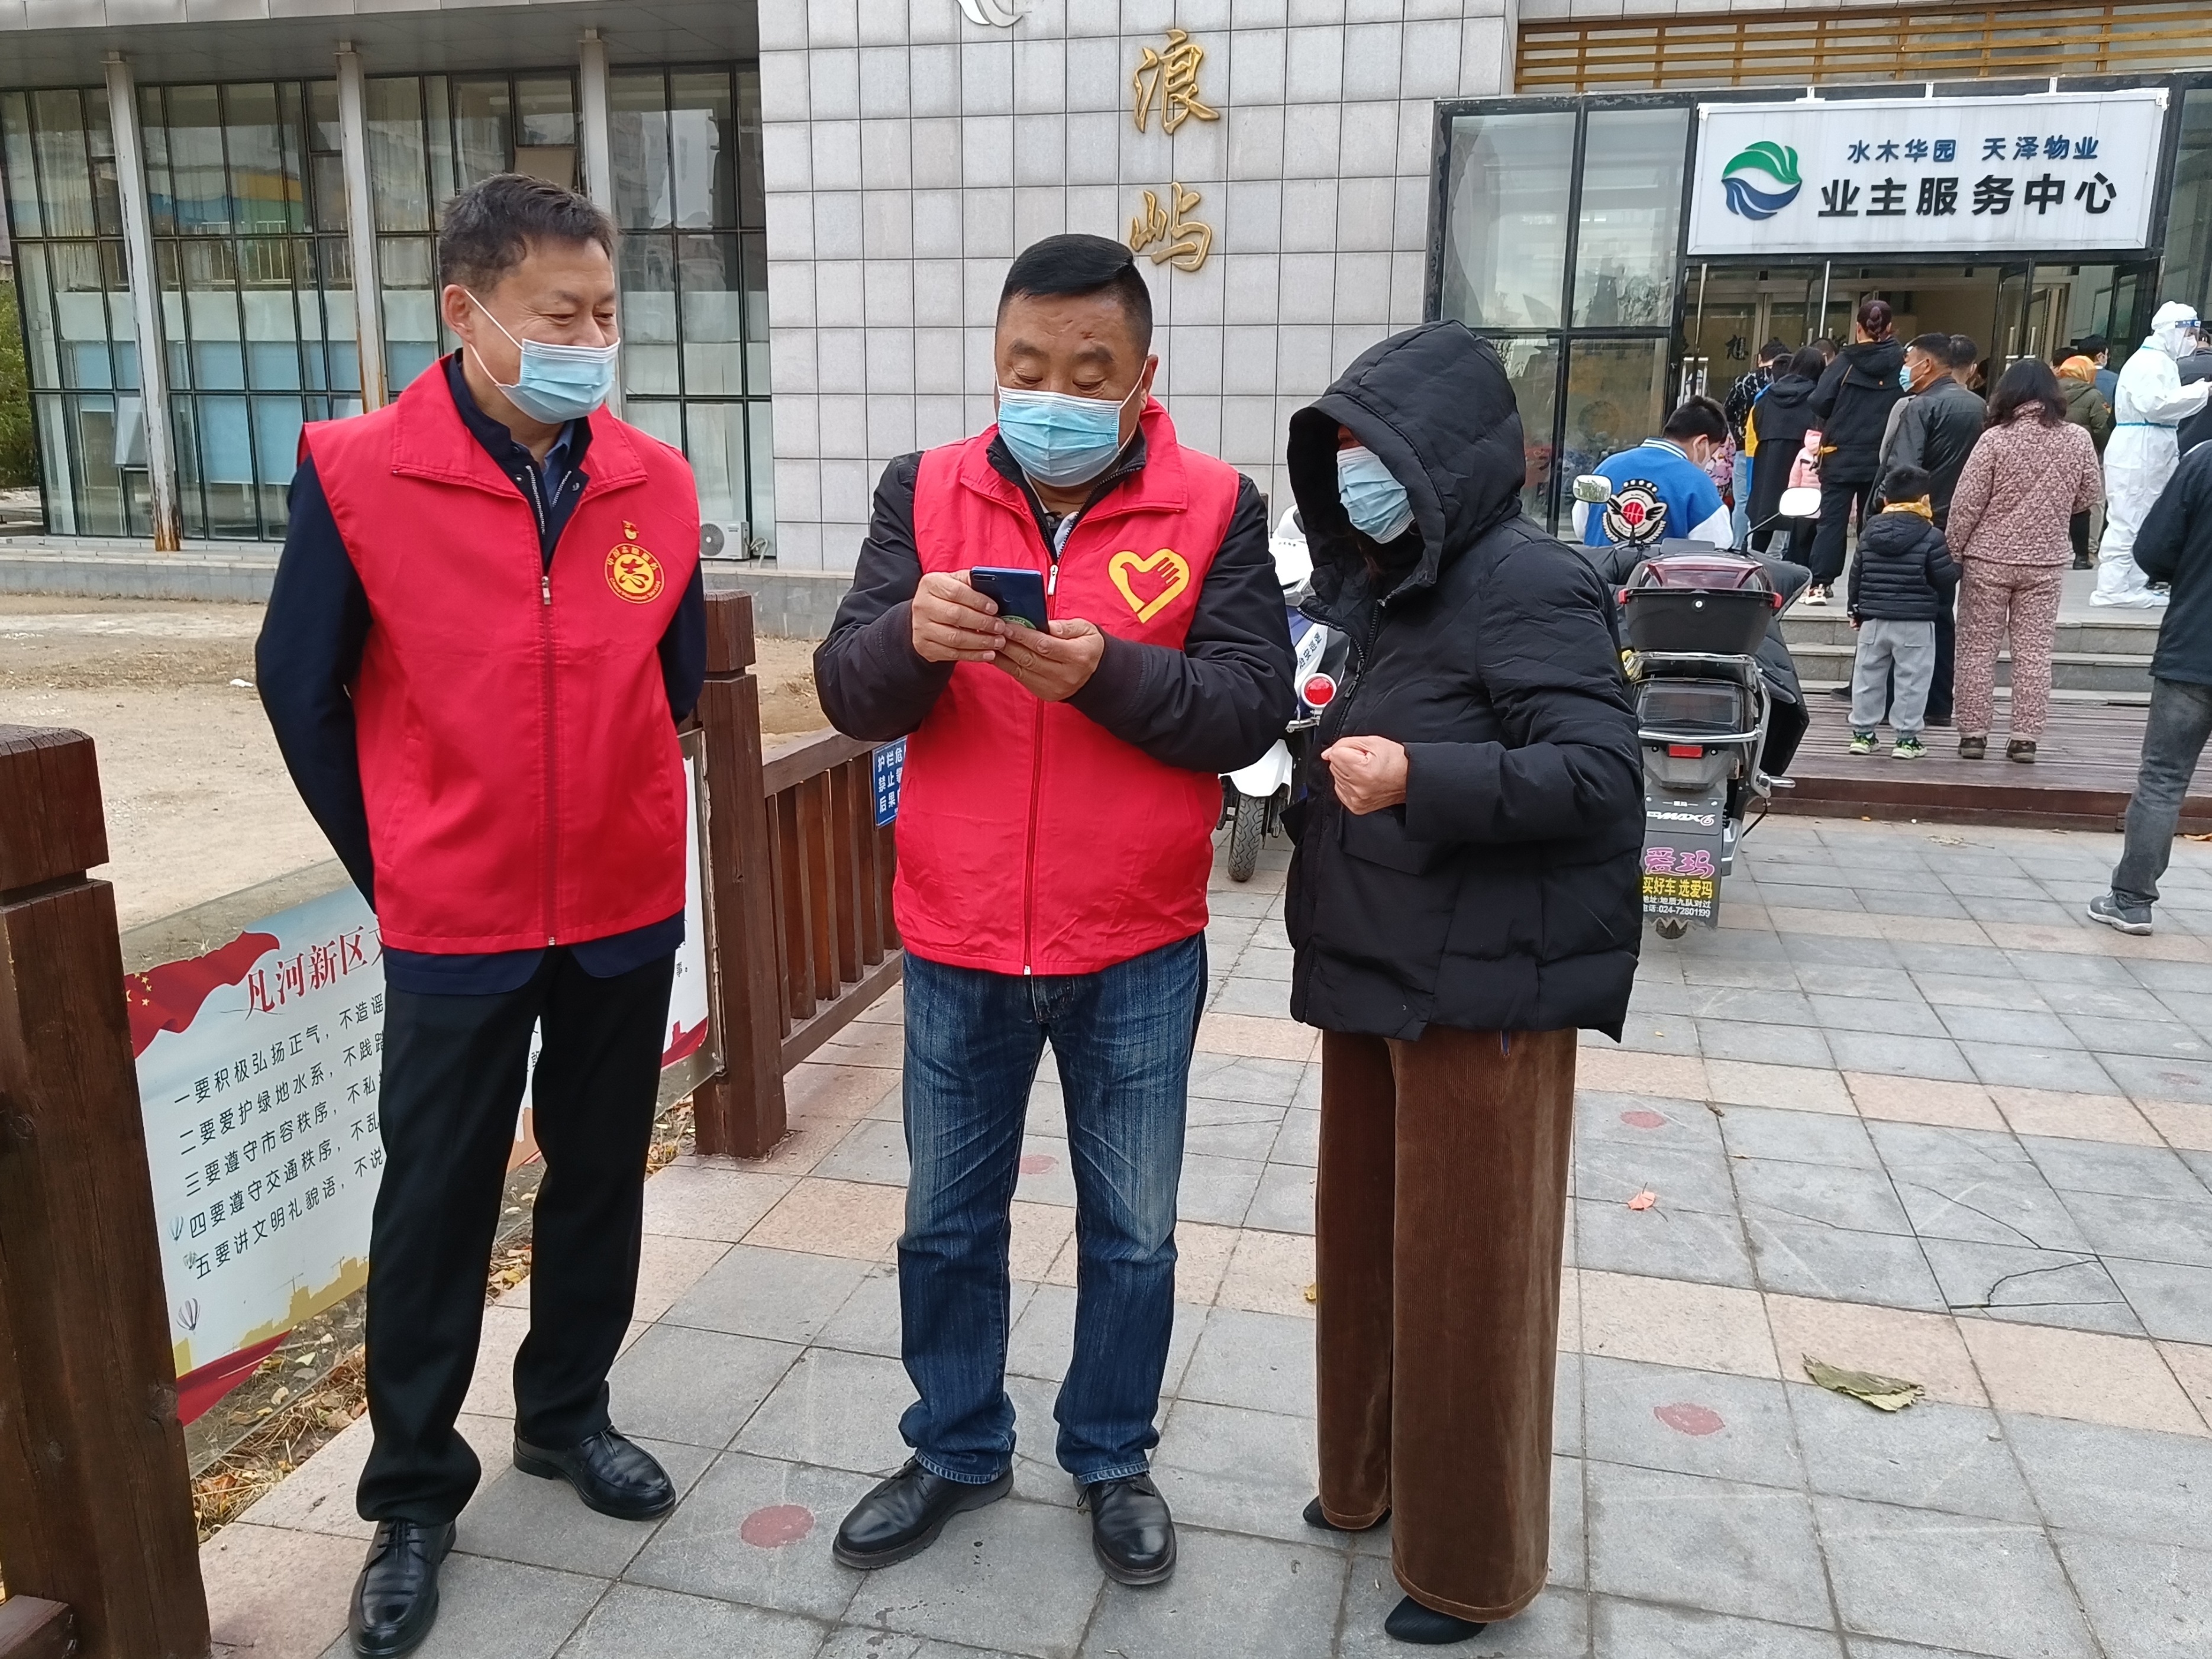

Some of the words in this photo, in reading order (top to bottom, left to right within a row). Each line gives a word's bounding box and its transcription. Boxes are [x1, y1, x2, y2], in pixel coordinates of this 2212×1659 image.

[1848, 138, 1957, 163] 水木华园
[1981, 135, 2099, 162] 天泽物业
[1817, 172, 2117, 218] 业主服务中心
[877, 744, 906, 773] 护栏危
[879, 789, 900, 814] 后果
[1645, 847, 1715, 879] 爱玛
[1643, 877, 1677, 896] 买好车
[1678, 879, 1713, 899] 选爱玛
[185, 1069, 383, 1198] 三要遵守市容秩序，不私
